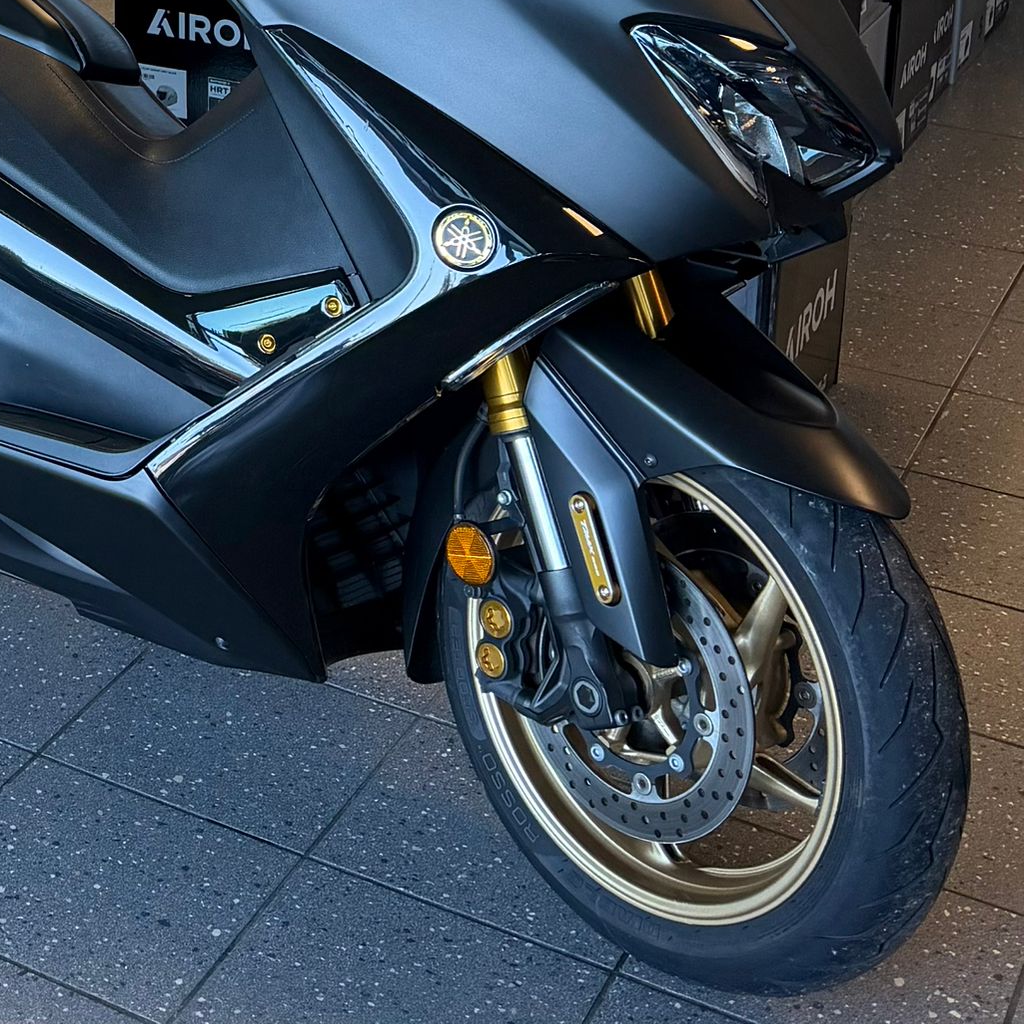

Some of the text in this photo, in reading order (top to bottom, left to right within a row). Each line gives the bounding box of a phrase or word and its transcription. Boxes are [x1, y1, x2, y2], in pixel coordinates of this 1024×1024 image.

[209, 85, 229, 95] HRT
[900, 42, 928, 89] AIROH
[786, 268, 838, 362] AIROH
[482, 752, 540, 843] ROSSO
